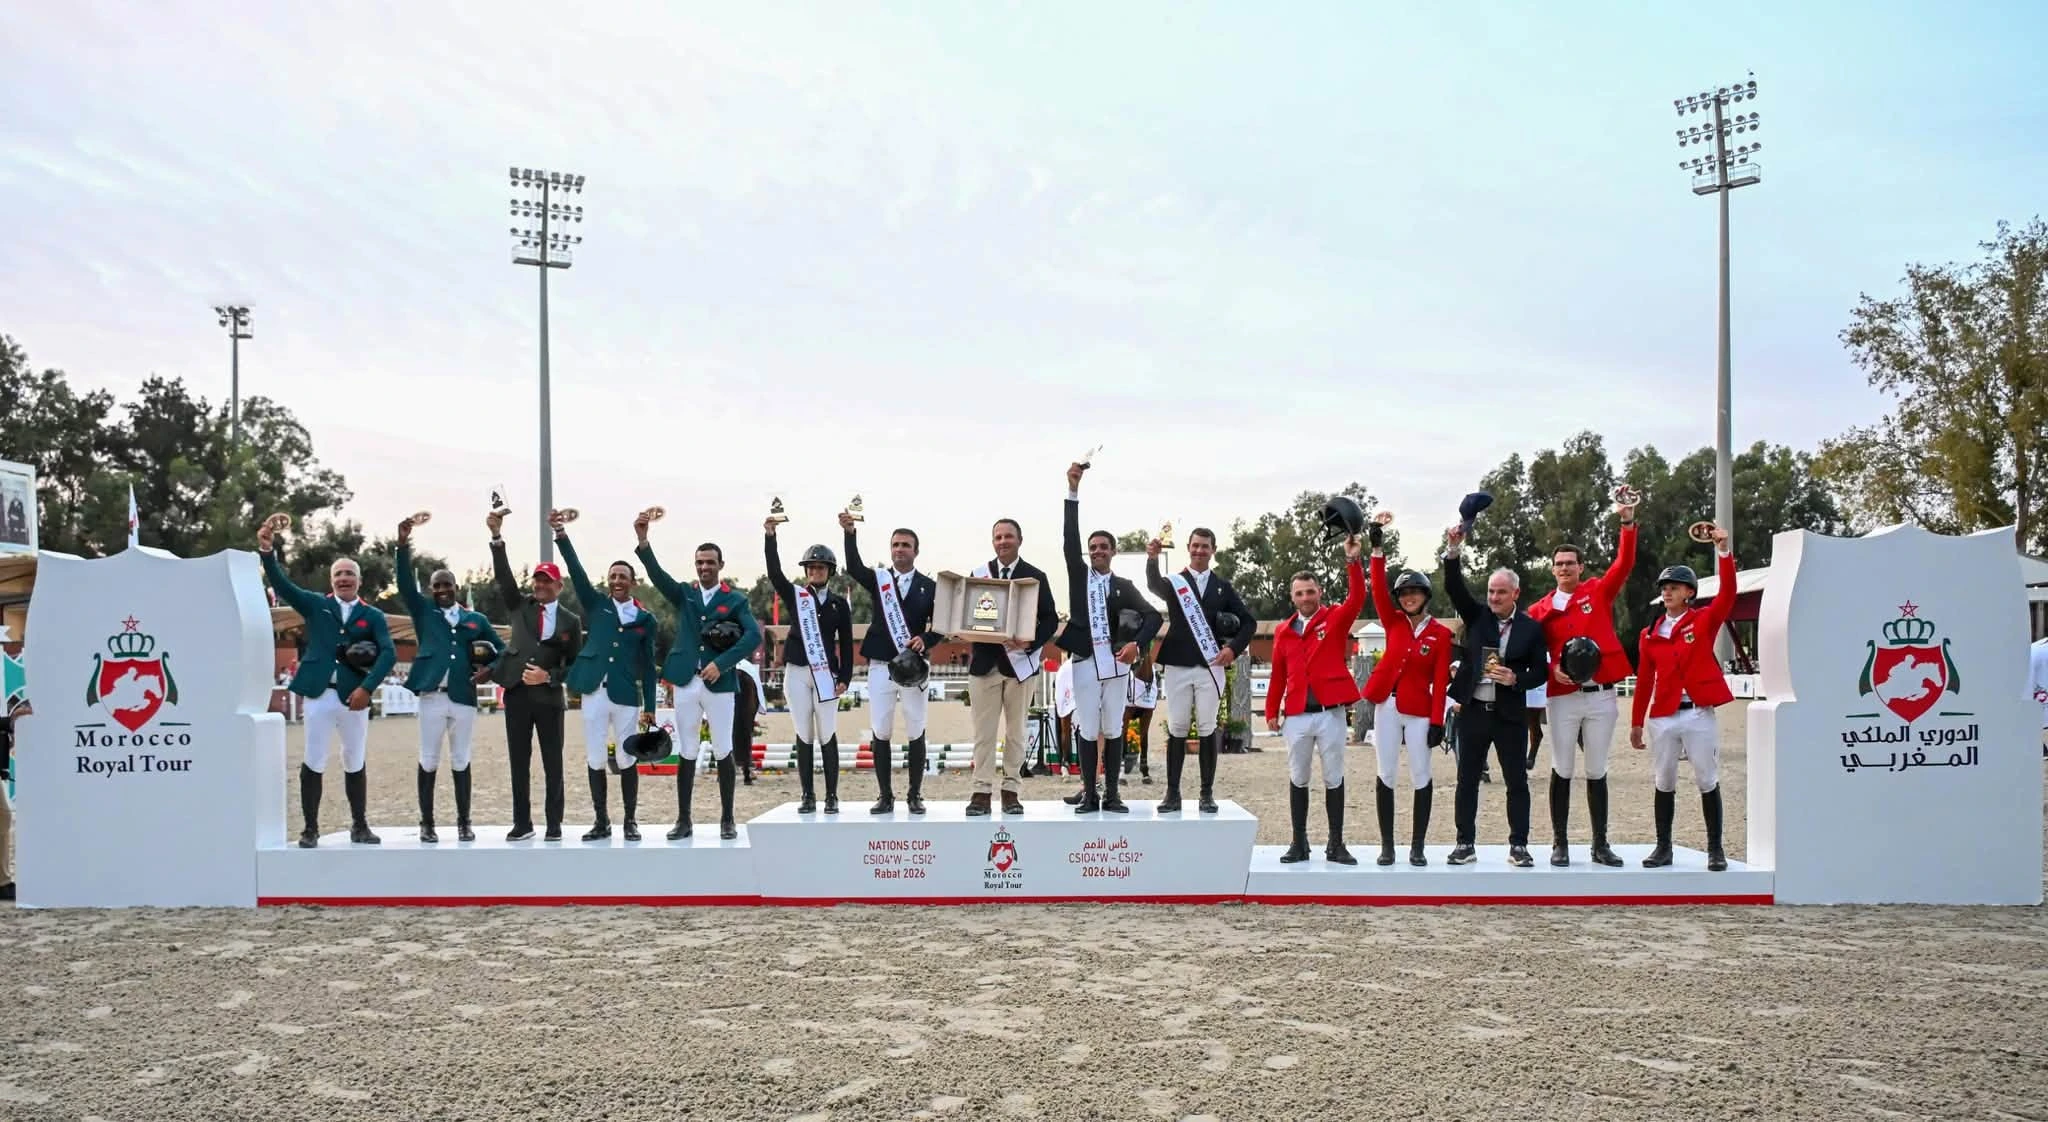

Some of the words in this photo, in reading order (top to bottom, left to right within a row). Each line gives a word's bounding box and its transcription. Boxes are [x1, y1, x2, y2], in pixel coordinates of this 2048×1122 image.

[75, 730, 191, 747] Morocco
[1841, 725, 1910, 748] الملكي
[1918, 724, 1979, 746] الدوري
[76, 754, 135, 778] Royal
[139, 755, 192, 772] Tour
[868, 840, 909, 850] NATIONS
[911, 840, 931, 850] CUP
[1083, 837, 1106, 852] الأمم
[1108, 836, 1128, 851] كأس
[874, 868, 900, 879] Rabat
[903, 868, 926, 879] 2026
[984, 871, 1023, 879] Morocco
[1082, 866, 1105, 877] 2026
[1108, 866, 1131, 879] الرباط
[984, 881, 1003, 891] Royal
[1005, 881, 1022, 889] Tour
